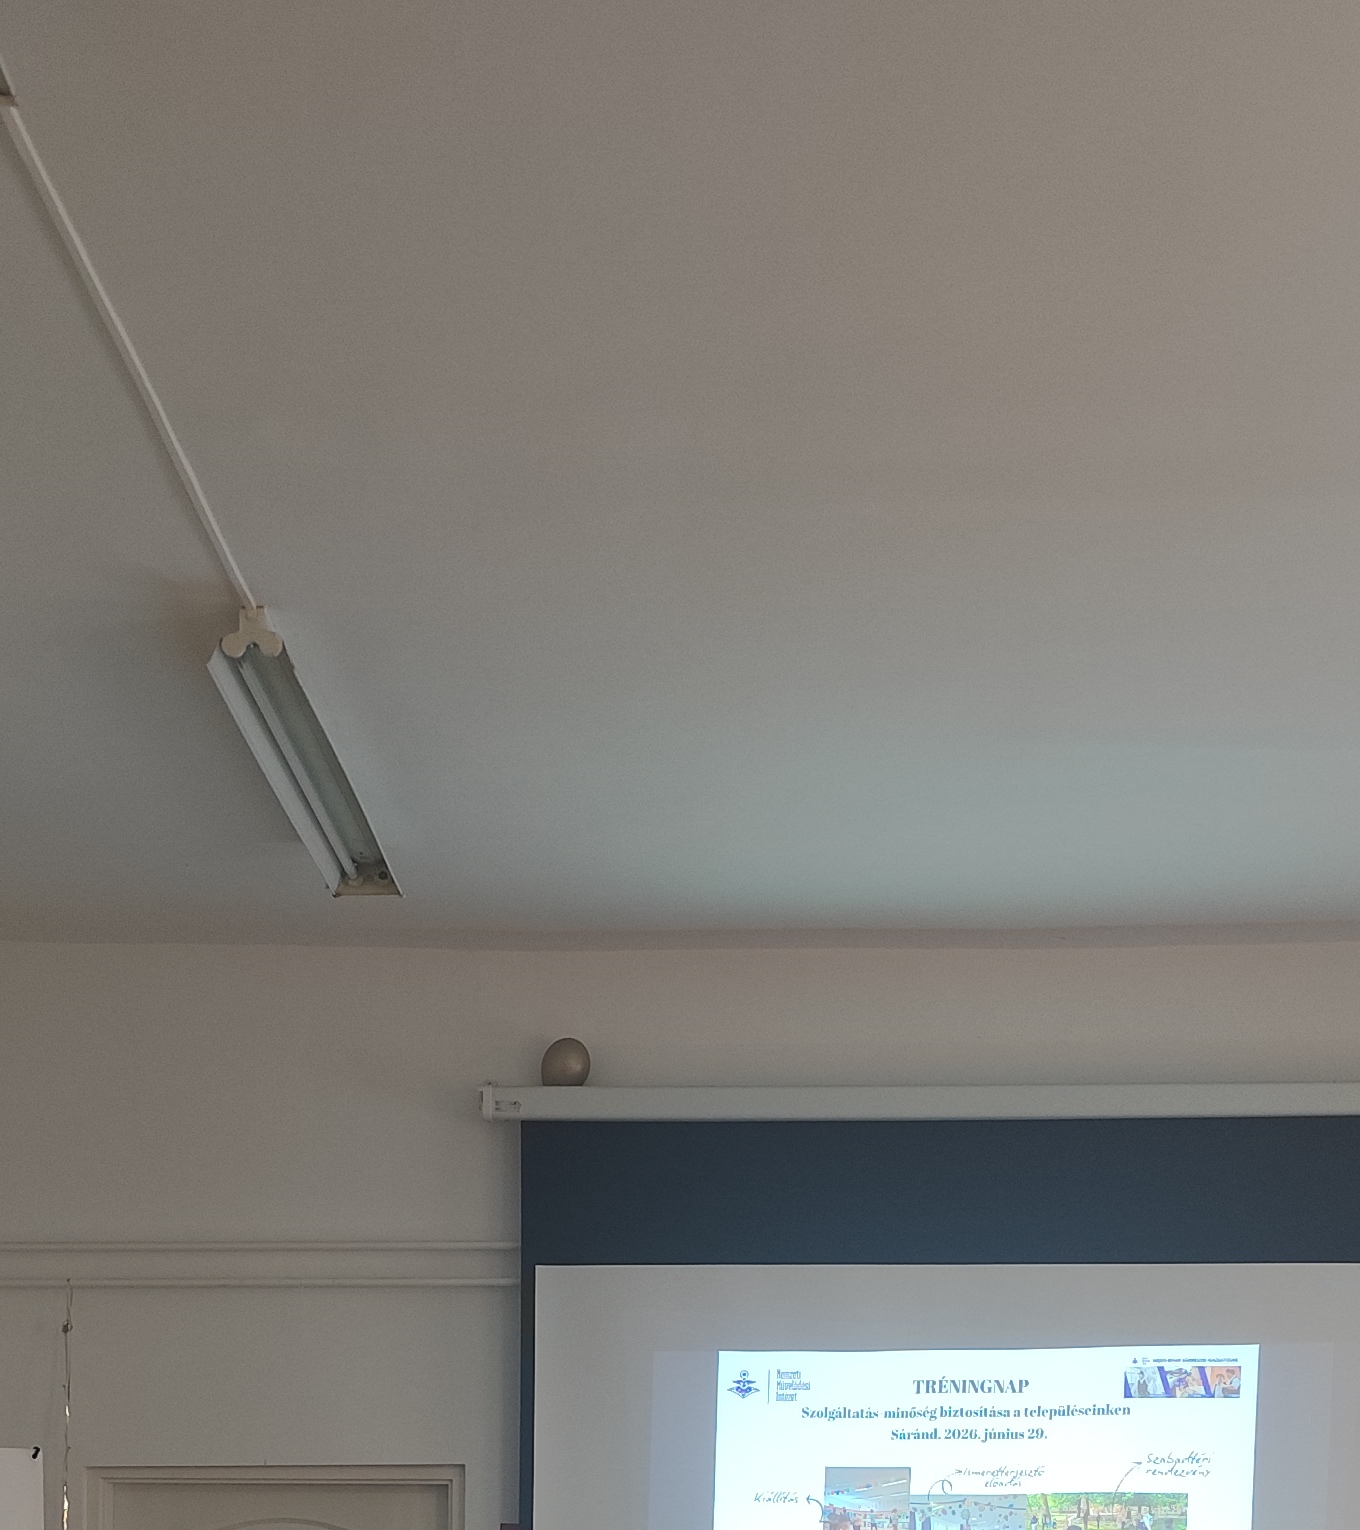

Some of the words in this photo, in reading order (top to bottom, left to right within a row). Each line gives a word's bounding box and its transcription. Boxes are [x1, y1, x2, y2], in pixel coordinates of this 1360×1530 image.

[912, 1376, 1030, 1395] TRÉNINGNAP
[939, 1405, 1011, 1418] biztosítása
[1013, 1409, 1021, 1418] a
[1024, 1403, 1131, 1421] településeinken
[980, 1427, 1025, 1443] június
[1027, 1427, 1048, 1440] 29.
